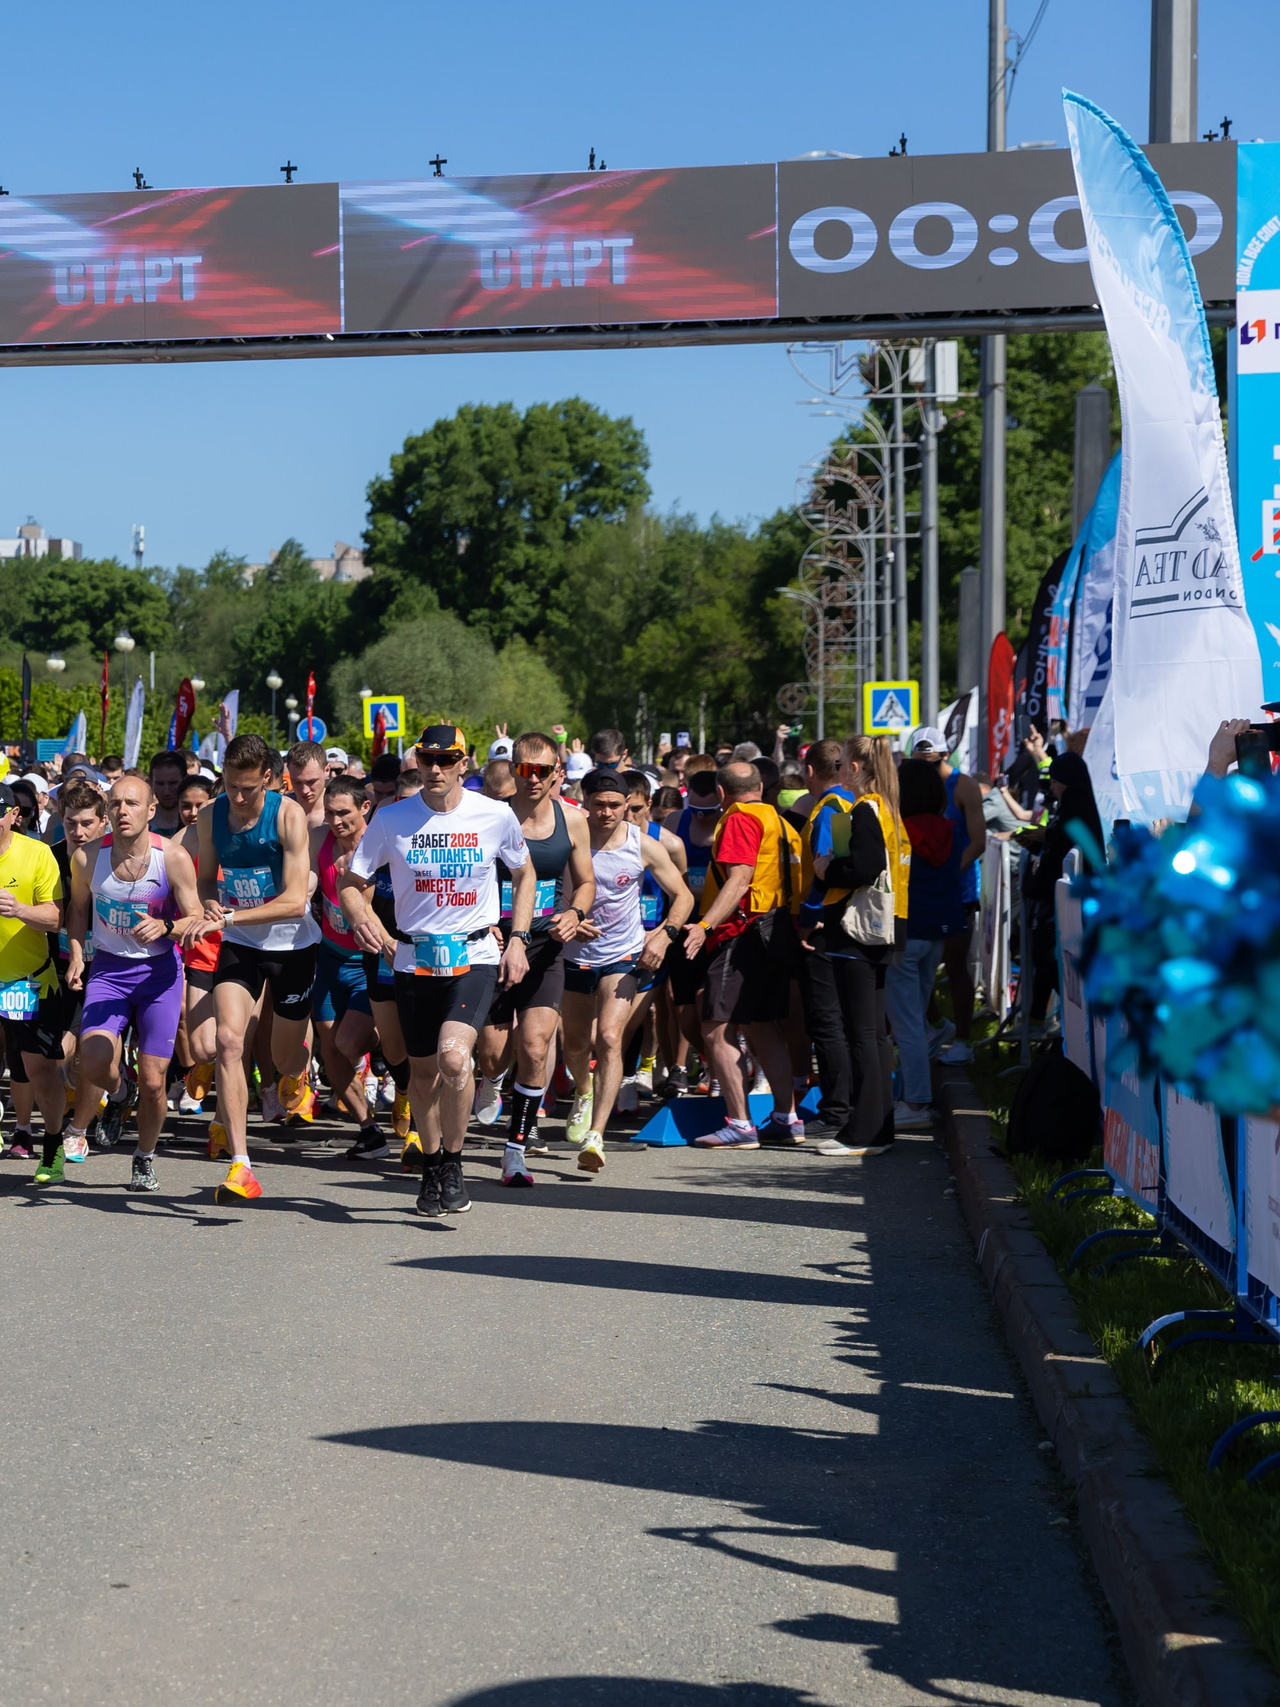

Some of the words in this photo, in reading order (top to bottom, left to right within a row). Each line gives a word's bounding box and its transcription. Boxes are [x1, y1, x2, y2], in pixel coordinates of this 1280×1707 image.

[479, 236, 634, 291] СТАРТ
[53, 254, 202, 307] СТАРТ
[406, 849, 429, 864] 45%
[431, 848, 483, 863] ПЛАНЕТЫ
[440, 864, 473, 878] БЕГУТ
[234, 878, 261, 898] 936
[415, 878, 456, 893] ВМЕСТЕ
[436, 893, 443, 907] С
[446, 888, 477, 907] ТОБОЙ
[535, 891, 542, 908] 7
[109, 908, 131, 928] 815
[432, 945, 450, 966] 70
[0, 991, 29, 1010] 1001
